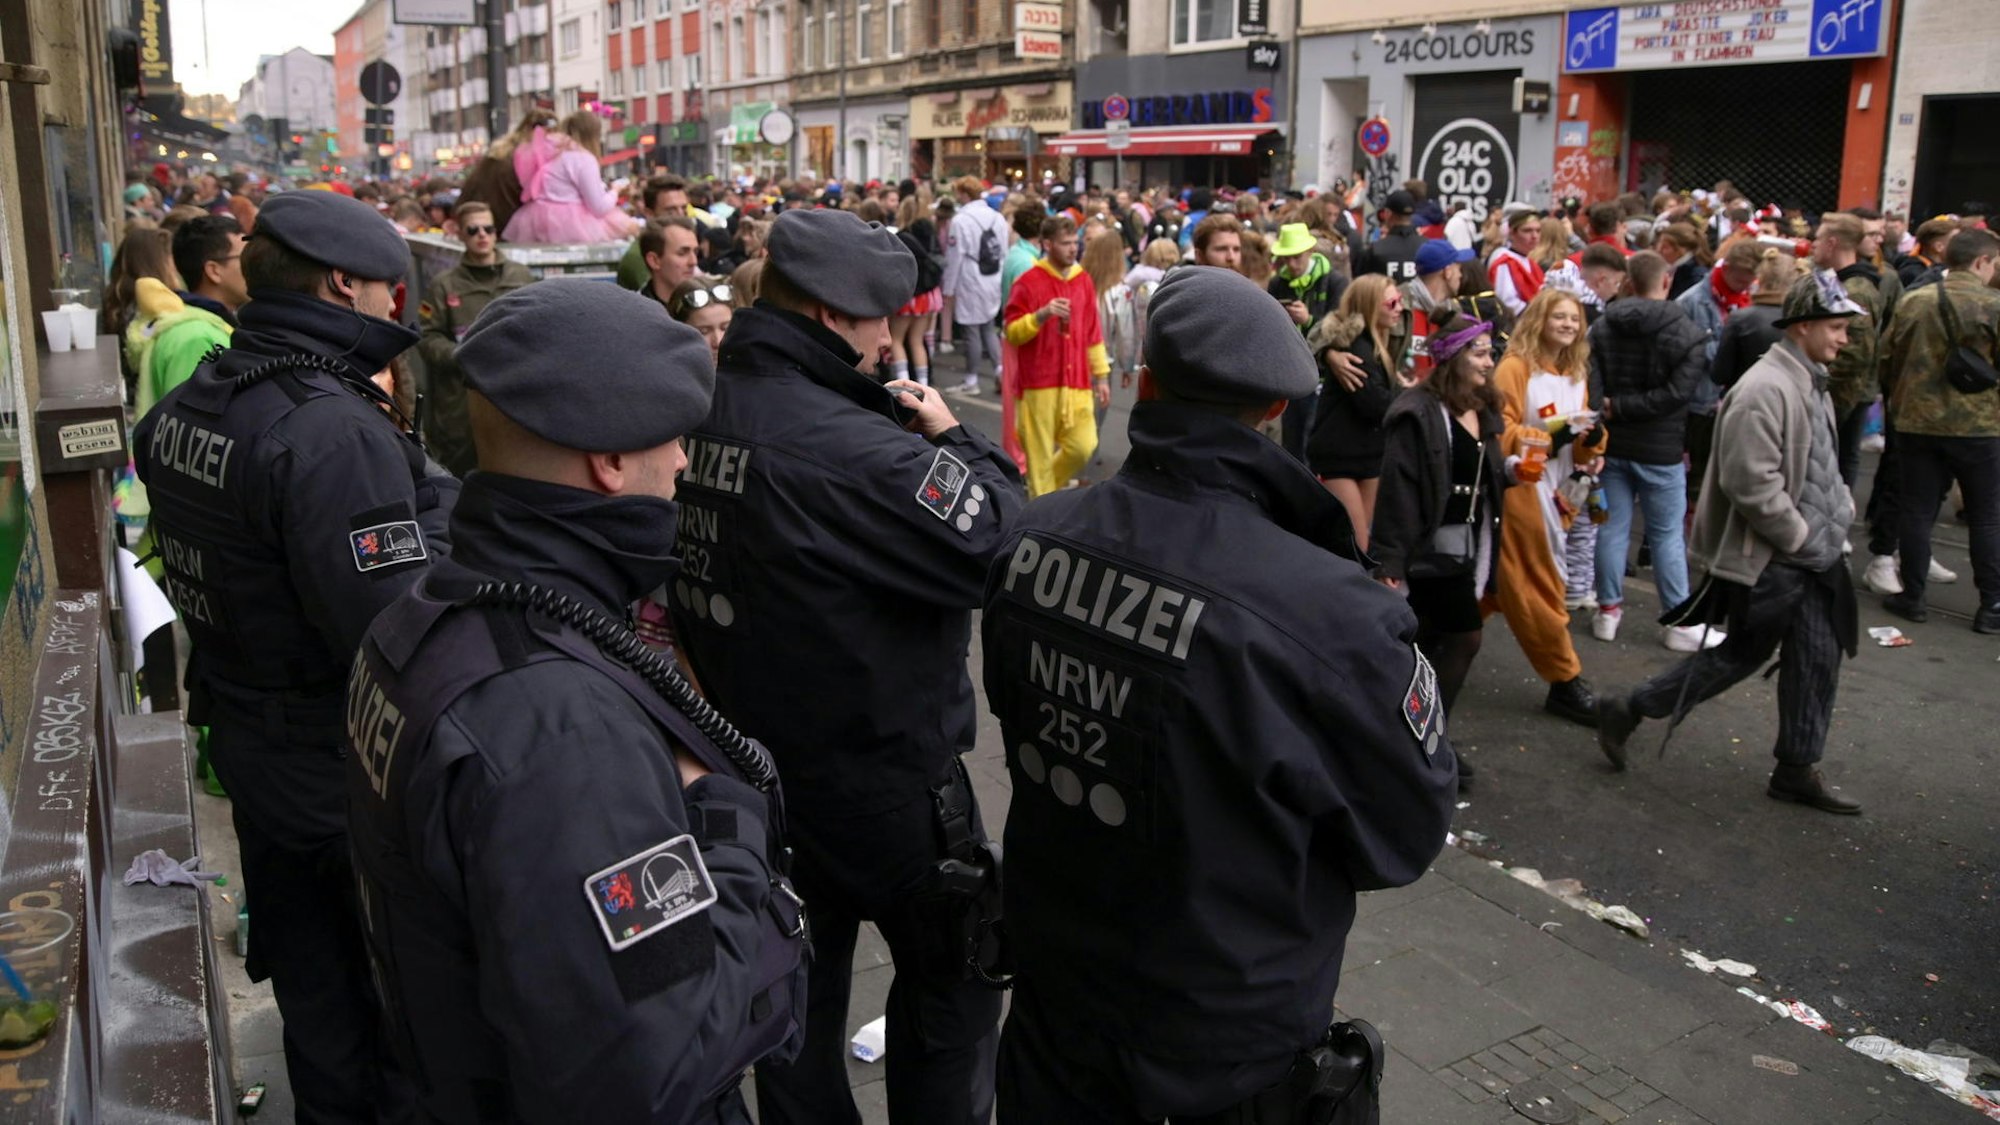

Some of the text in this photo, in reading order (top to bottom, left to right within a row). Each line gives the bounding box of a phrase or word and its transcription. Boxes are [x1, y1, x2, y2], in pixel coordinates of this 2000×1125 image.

[1569, 11, 1615, 68] OFF
[1634, 27, 1776, 50] PORTRAIT EINER FRAU
[1661, 10, 1789, 32] PARASITE JOKER
[1816, 0, 1875, 52] OFF
[1254, 46, 1278, 67] sky
[1384, 30, 1534, 63] 24COLOURS
[1672, 45, 1754, 62] IN FLAMMEN
[1441, 140, 1492, 168] 24C
[1437, 167, 1493, 195] OLO
[65, 439, 115, 454] Cesena
[150, 412, 234, 489] POLIZEI
[677, 435, 750, 495] LIZEI
[162, 532, 204, 582] NRW
[1003, 537, 1205, 661] POLIZEI
[1030, 640, 1133, 719] NRW
[1039, 701, 1108, 768] 252
